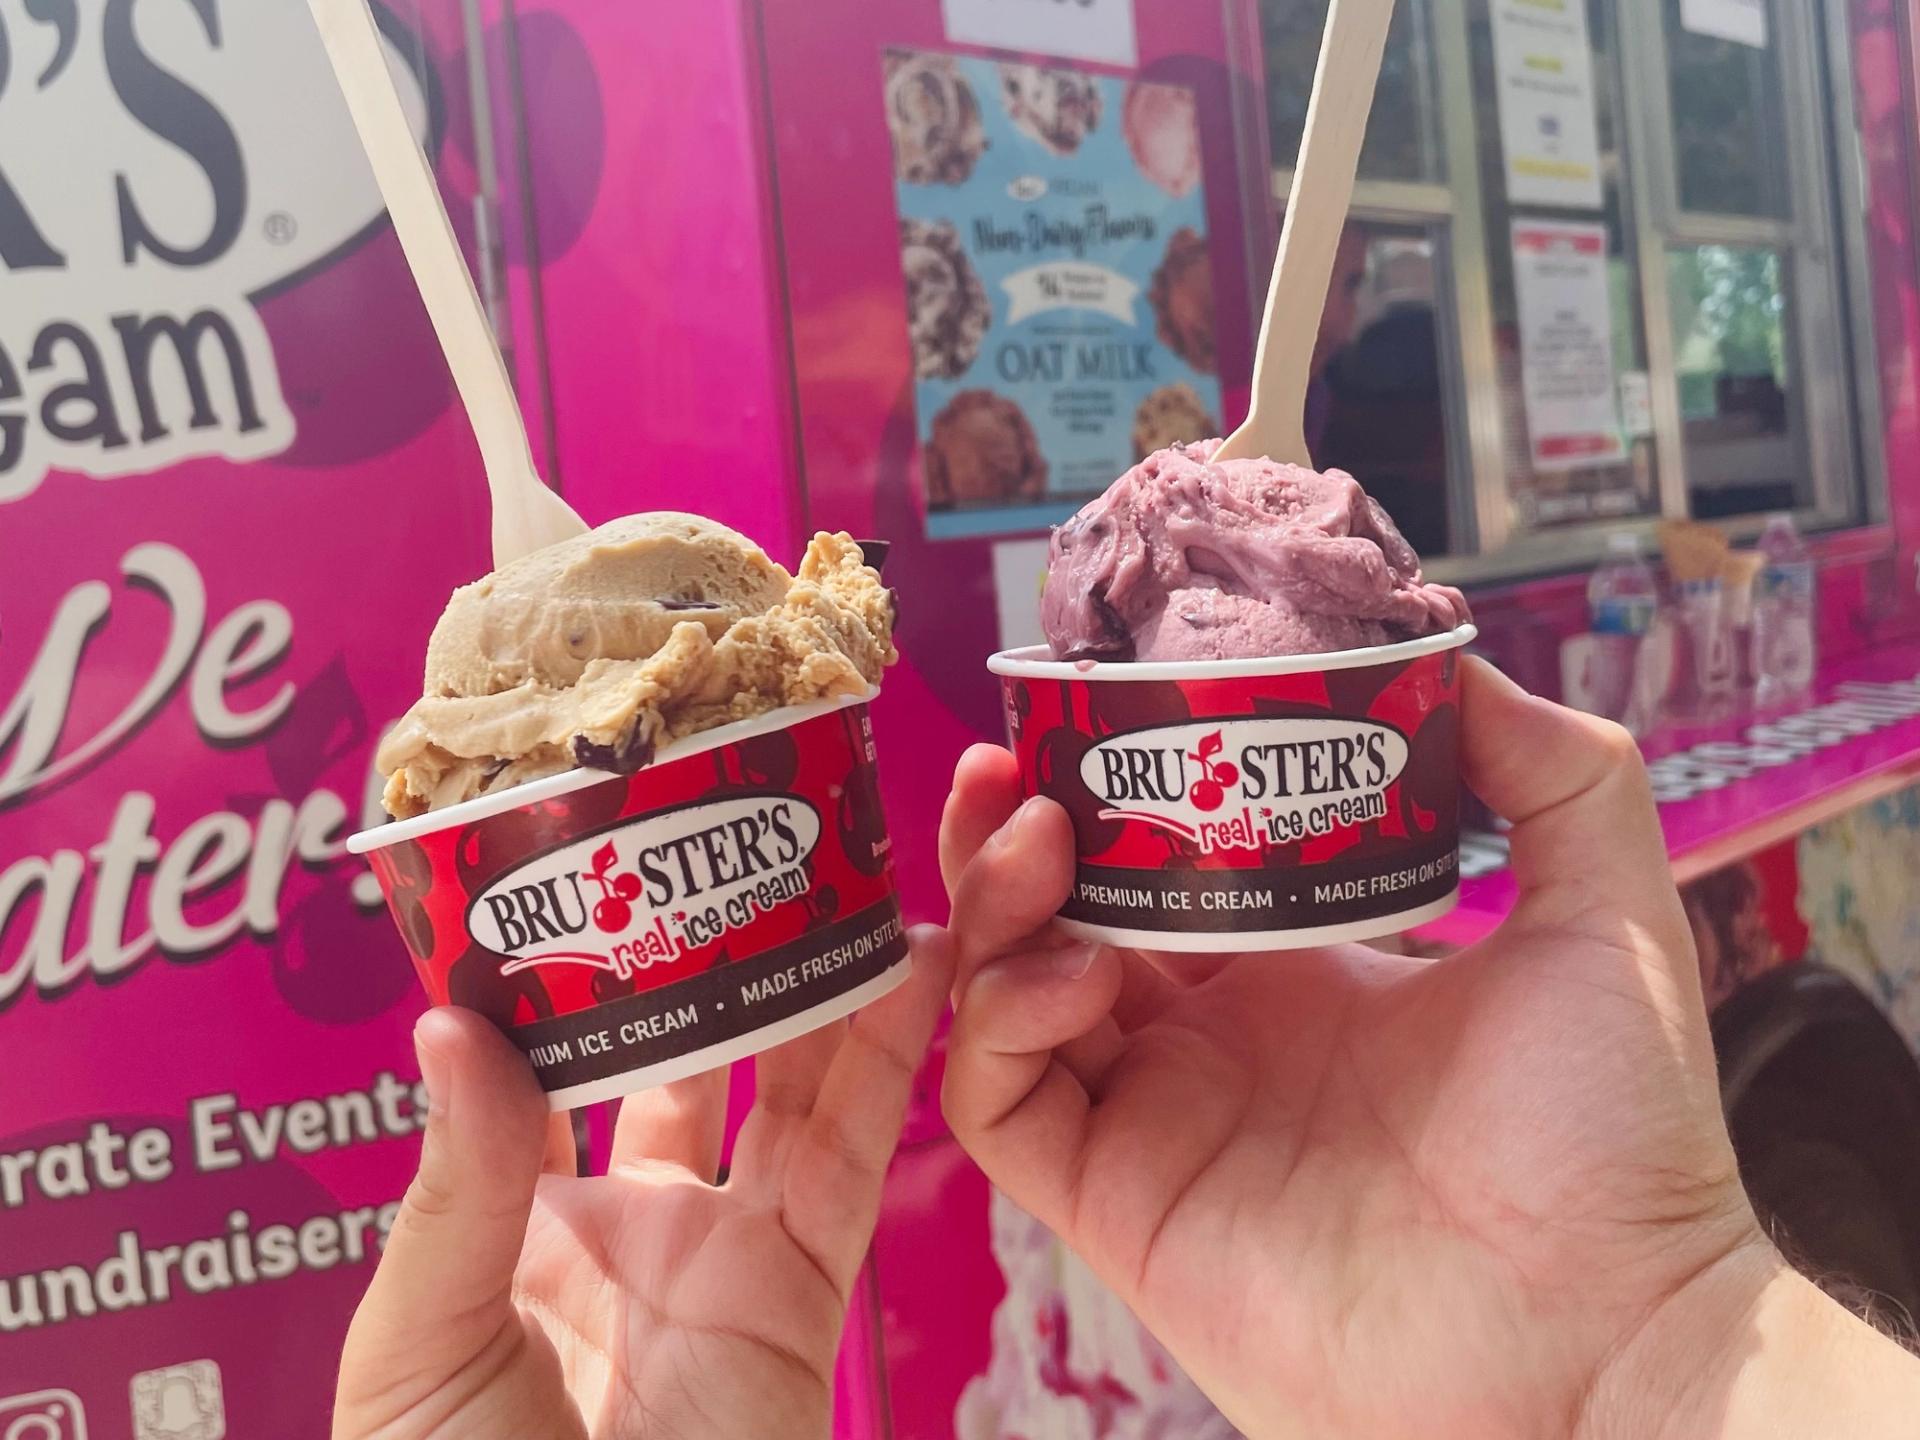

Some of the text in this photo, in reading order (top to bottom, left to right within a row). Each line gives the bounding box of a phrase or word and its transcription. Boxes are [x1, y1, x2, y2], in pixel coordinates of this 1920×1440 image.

[0, 0, 248, 269] 'S
[996, 341, 1157, 383] OAT MILK
[1200, 791, 1385, 851] real ice cream
[612, 868, 808, 976] real ice cream
[1080, 883, 1153, 909] PREMIUM
[1161, 891, 1192, 910] ICE
[1200, 890, 1273, 910] CREAM
[1314, 879, 1367, 904] MADE
[1370, 867, 1416, 896] FRESH
[1418, 863, 1435, 883] ON
[577, 1030, 614, 1057] ICE
[619, 1004, 699, 1045] CREAM
[740, 967, 801, 1006] MADE
[801, 943, 853, 982] FRESH
[854, 932, 873, 958] ON
[873, 921, 893, 948] SITE
[0, 1122, 173, 1206] rate
